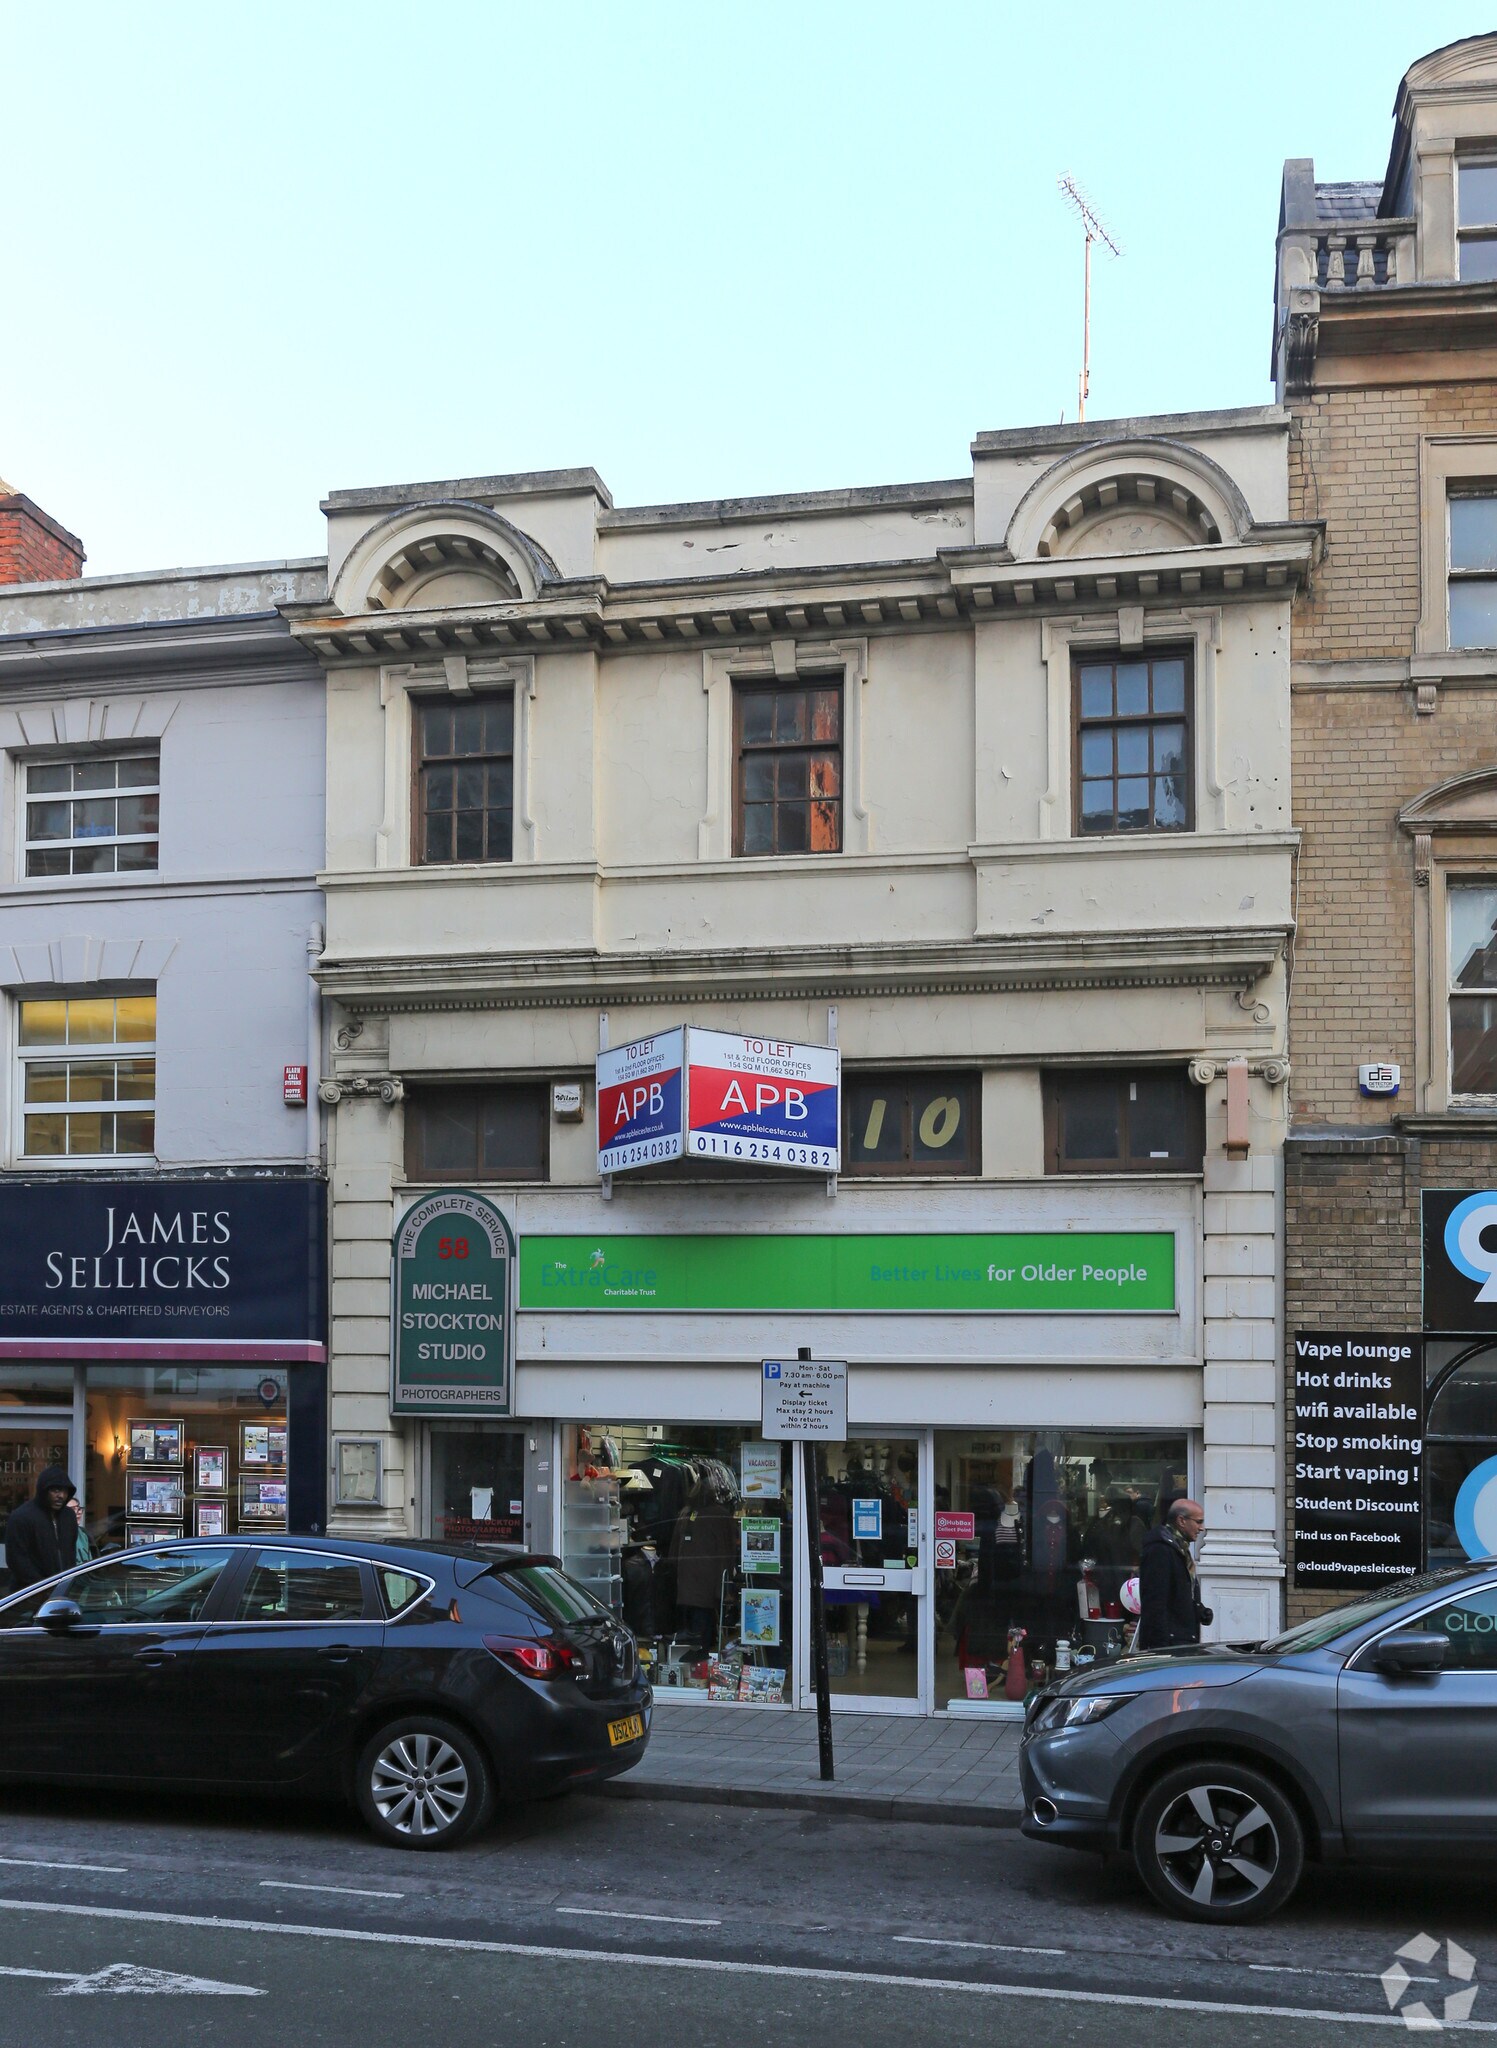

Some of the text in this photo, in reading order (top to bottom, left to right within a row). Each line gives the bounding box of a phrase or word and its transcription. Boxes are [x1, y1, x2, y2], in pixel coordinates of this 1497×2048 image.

[626, 1040, 655, 1060] TO LET
[743, 1039, 794, 1058] TO LET
[633, 1060, 647, 1070] FLOOR
[647, 1054, 665, 1065] OFFICES
[742, 1055, 755, 1063] 2nd
[757, 1057, 780, 1066] FLOOR
[782, 1060, 812, 1071] OFFICES
[784, 1068, 794, 1076] SQ
[796, 1070, 807, 1078] FT)
[614, 1082, 664, 1125] APB
[720, 1080, 808, 1120] APB
[614, 1122, 664, 1141] www.apbleicester.co.uk
[720, 1121, 808, 1138] www.apbleicester.co.uk
[603, 1139, 677, 1168] 0116 254 0382
[697, 1137, 830, 1166] 0116 254 0382
[102, 1207, 230, 1255] JAMES
[402, 1198, 505, 1255] THE COMPLETE SERVICE
[438, 1237, 469, 1259] 58
[45, 1251, 230, 1289] SELLICKS
[541, 1263, 657, 1287] ExtraCare
[870, 1264, 1148, 1286] Better Lives for Older People
[412, 1283, 493, 1300] MICHAEL
[0, 1305, 230, 1316] ESTATE AGENTS & CHARTERED SURVEYORS
[402, 1312, 503, 1330] STOCKTON
[417, 1343, 486, 1360] STUDIO
[1296, 1341, 1412, 1362] Vape lounge
[769, 1365, 778, 1377] P
[1296, 1371, 1392, 1388] Hot drinks
[401, 1388, 501, 1401] PHOTOGRAPHERS
[1296, 1402, 1417, 1420] wifi available
[17, 1444, 62, 1460] JAMES
[1295, 1433, 1422, 1455] Stop smoking
[748, 1459, 776, 1467] VACANCIES
[1295, 1463, 1419, 1485] Start vaping !
[1295, 1497, 1419, 1512] Student Discount
[1295, 1530, 1318, 1540] Find
[1334, 1533, 1348, 1541] on
[1350, 1532, 1401, 1543] Facebook
[1296, 1561, 1416, 1574] @cloud9vapesleicester
